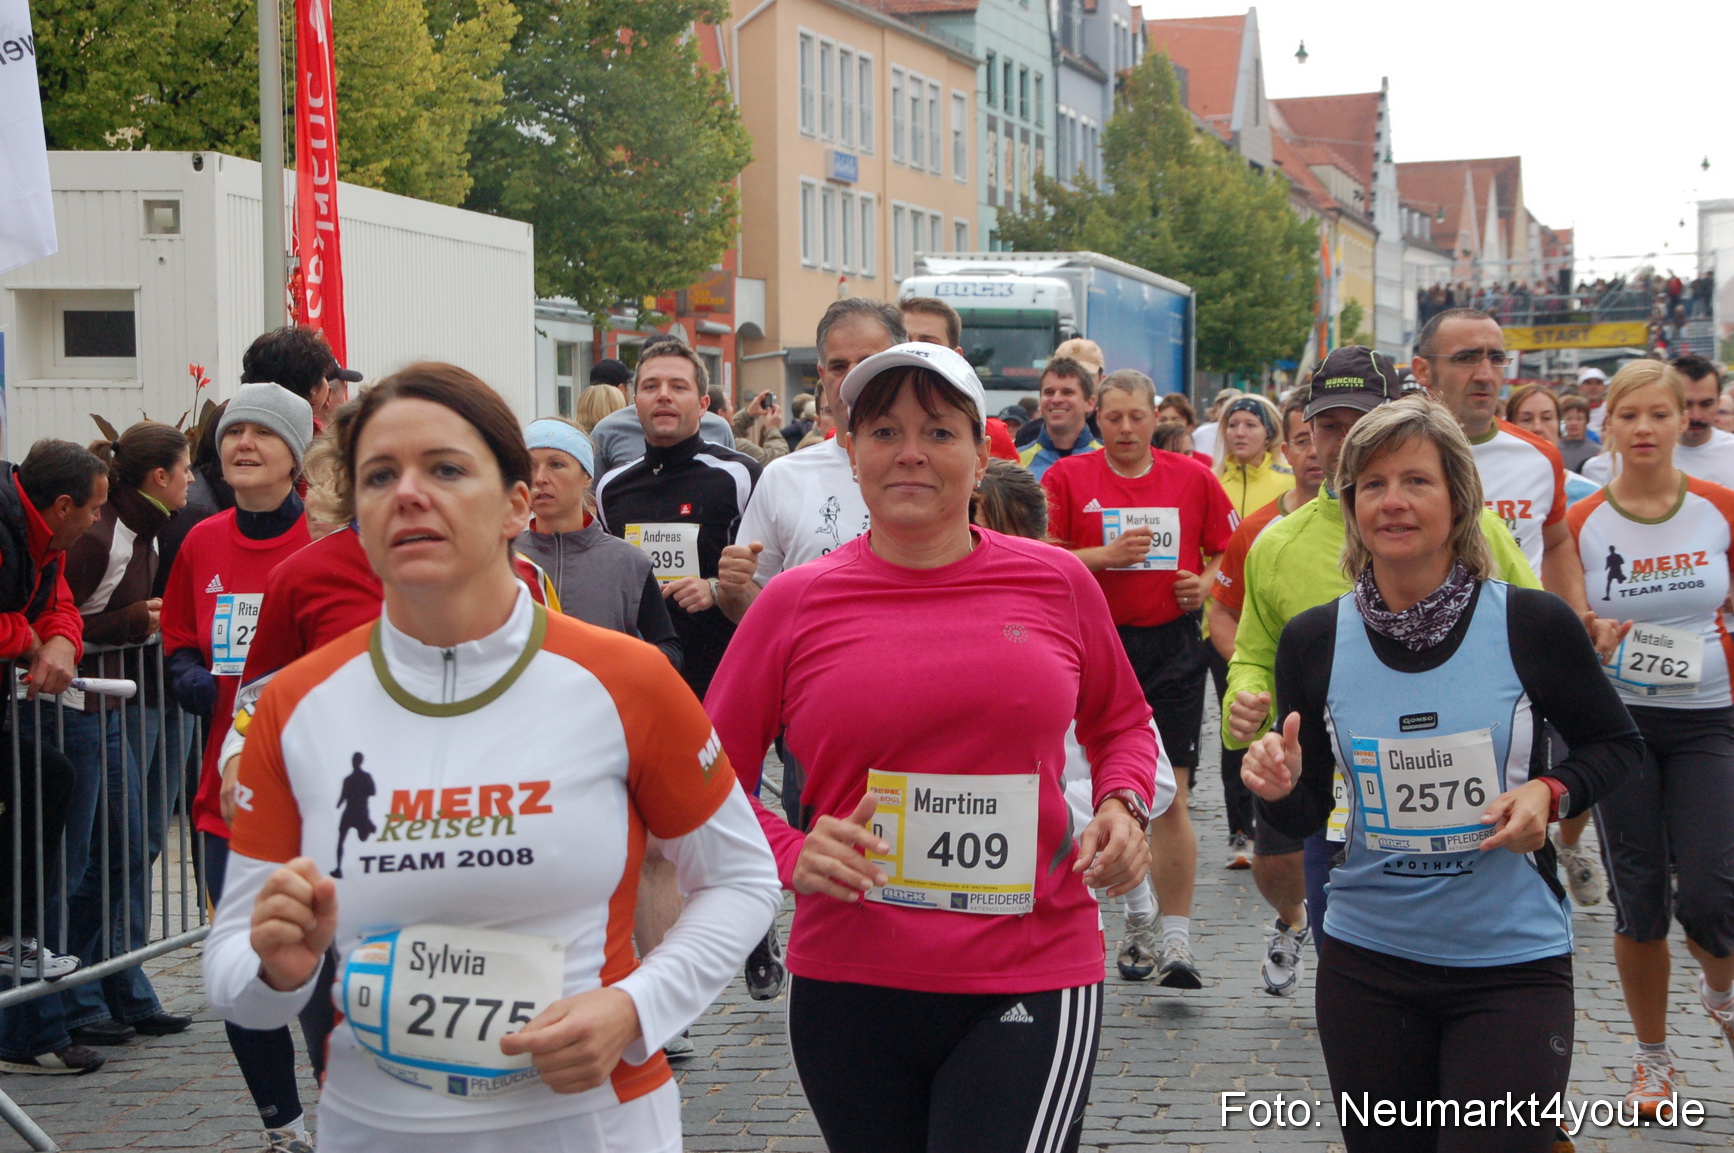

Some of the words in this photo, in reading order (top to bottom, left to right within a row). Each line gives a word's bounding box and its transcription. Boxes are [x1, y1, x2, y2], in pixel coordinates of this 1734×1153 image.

[934, 281, 1015, 297] BOCK
[1533, 328, 1592, 345] START
[1126, 514, 1160, 525] Markus
[643, 529, 682, 542] Andreas
[651, 550, 685, 568] 395
[1632, 550, 1709, 575] MERZ
[1627, 566, 1696, 584] Reisen
[1619, 584, 1663, 598] TEAM
[1668, 579, 1705, 591] 2008
[238, 602, 258, 616] Rita
[1633, 629, 1674, 649] Natalie
[1629, 652, 1689, 679] 2762
[1388, 748, 1453, 771] Claudia
[390, 780, 553, 823] MERZ
[914, 787, 997, 815] Martina
[1395, 777, 1486, 813] 2576
[376, 809, 517, 842] Reisen
[360, 851, 446, 874] TEAM
[457, 847, 535, 868] 2008
[927, 831, 1009, 870] 409
[882, 887, 926, 901] BOCK
[970, 893, 1031, 905] PFLEIDERER
[410, 941, 486, 979] Sylvia
[406, 993, 536, 1041] 2775
[1000, 1013, 1034, 1024] adidas
